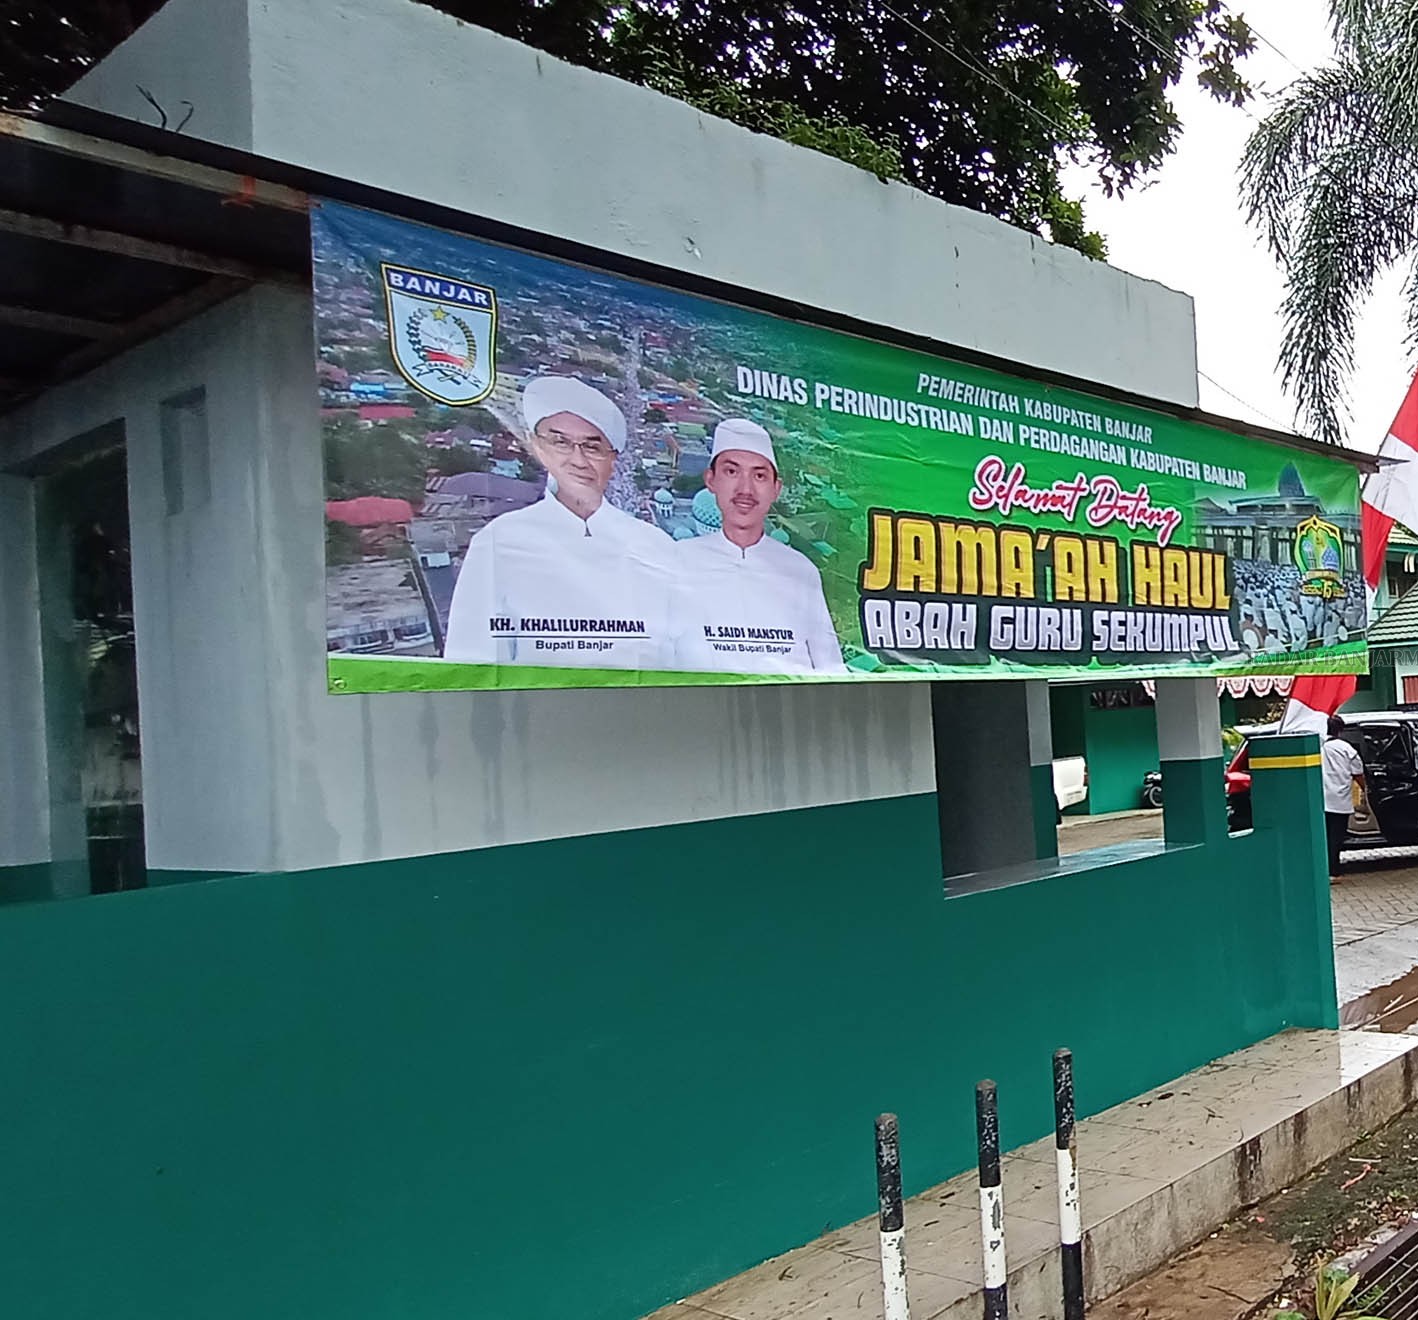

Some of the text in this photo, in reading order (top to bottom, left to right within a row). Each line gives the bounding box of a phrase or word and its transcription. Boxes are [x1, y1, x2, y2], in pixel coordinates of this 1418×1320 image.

[389, 272, 488, 306] BANJAR
[736, 366, 1246, 490] DINAS PERINDUSTRIAN DAN PERDAGANGAN KABUPATEN BANJAR
[917, 373, 1153, 444] PEMERINTAH KABUPATEN BANJAR
[969, 456, 1184, 547] Selamat Datang
[863, 514, 1230, 610] JAMA'AH HAUL
[490, 618, 645, 633] KH. KHALILURRAHMAN
[535, 640, 614, 651] Bupati Banjar
[704, 625, 794, 640] H. SAIDI MANSYUR
[864, 600, 1239, 651] ABAH GURU SEKUMPUL
[713, 643, 792, 655] Wakil Bupati Banjar
